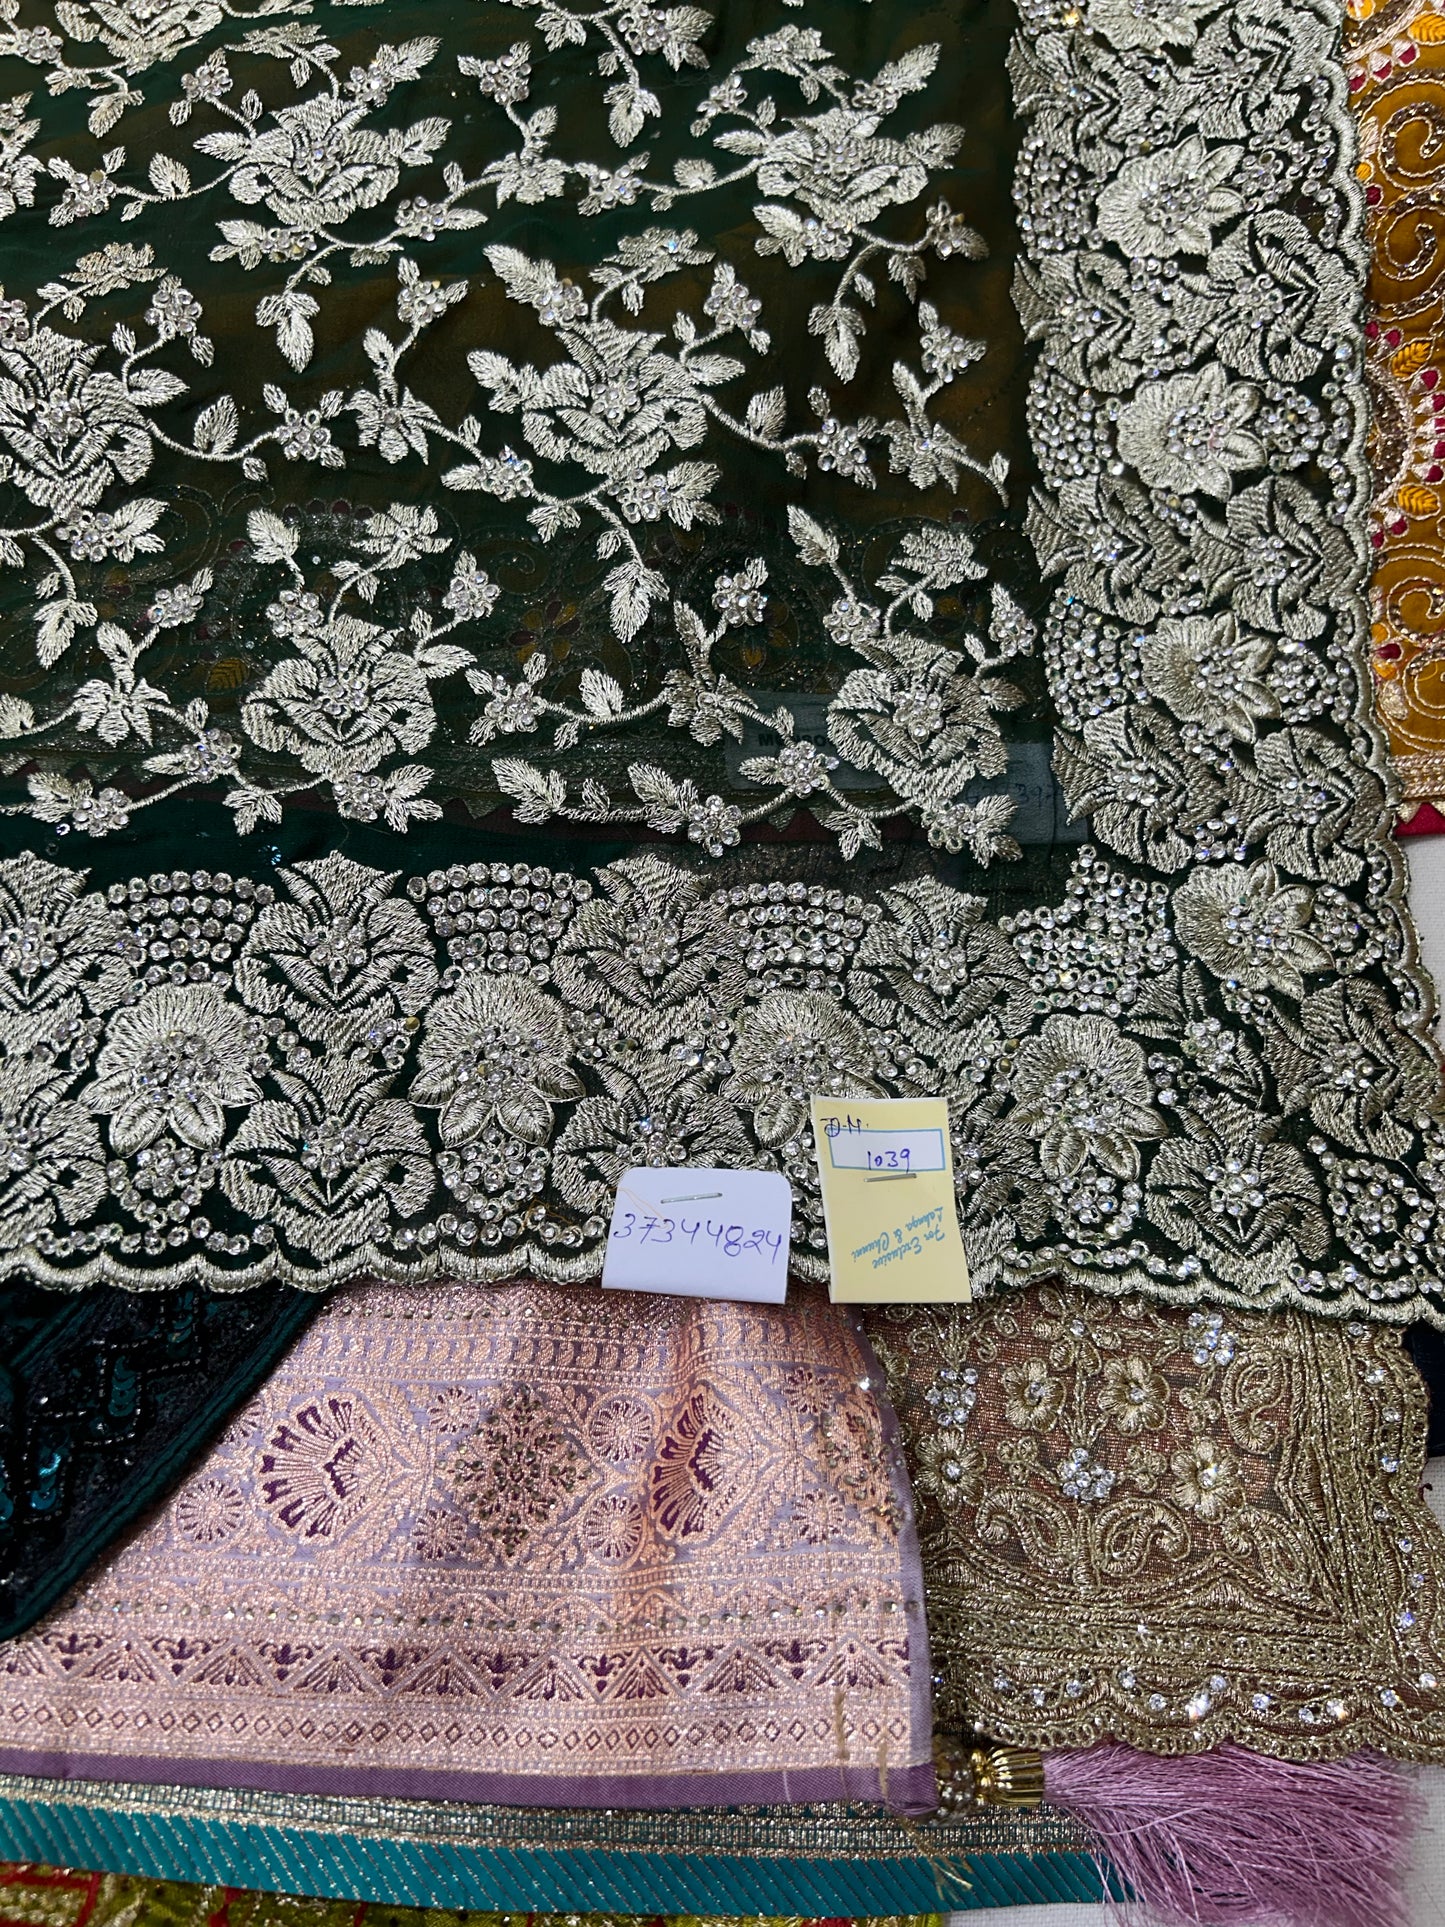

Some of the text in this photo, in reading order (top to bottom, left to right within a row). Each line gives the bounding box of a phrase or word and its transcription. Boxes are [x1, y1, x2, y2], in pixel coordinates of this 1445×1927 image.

[867, 1148, 911, 1174] 1039
[613, 1213, 782, 1265] 37344824
[850, 1231, 890, 1264] Chunni
[872, 1223, 946, 1269] For Exclusive
[892, 1228, 903, 1244] &
